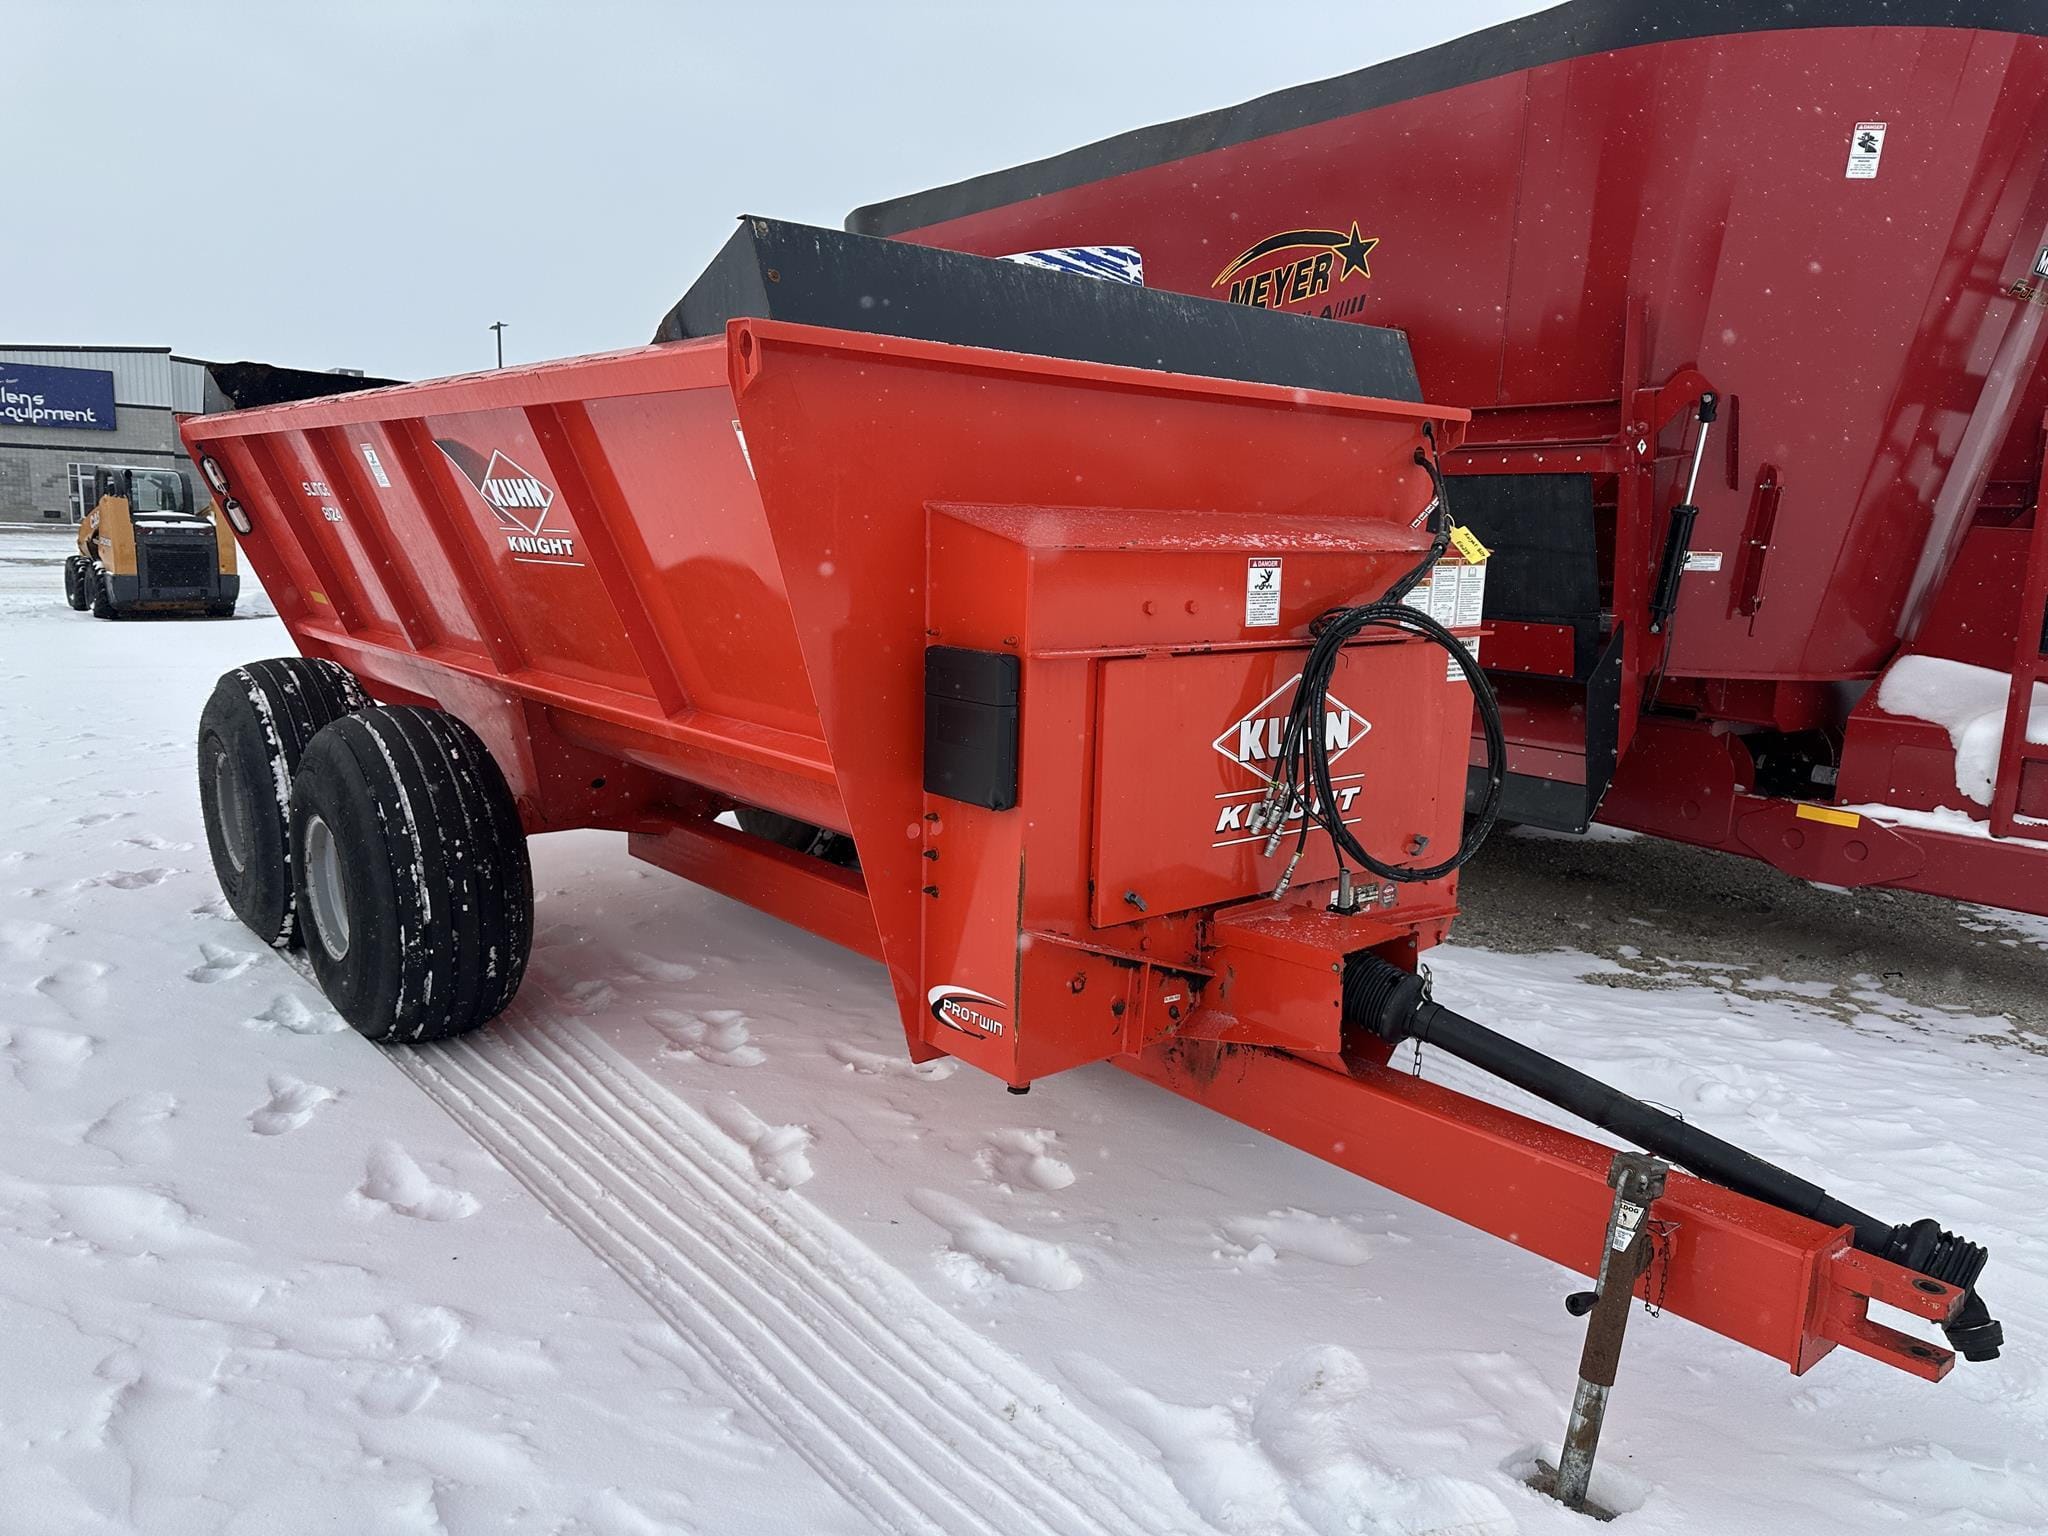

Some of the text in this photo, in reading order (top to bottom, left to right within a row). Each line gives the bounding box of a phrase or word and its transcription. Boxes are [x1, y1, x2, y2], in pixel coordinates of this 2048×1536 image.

[1229, 252, 1334, 309] MEYER
[0, 386, 44, 405] lens
[486, 479, 548, 508] KUHN
[506, 536, 574, 556] KNIGHT
[1239, 710, 1350, 762] KUN
[943, 999, 1003, 1036] PROTWIN
